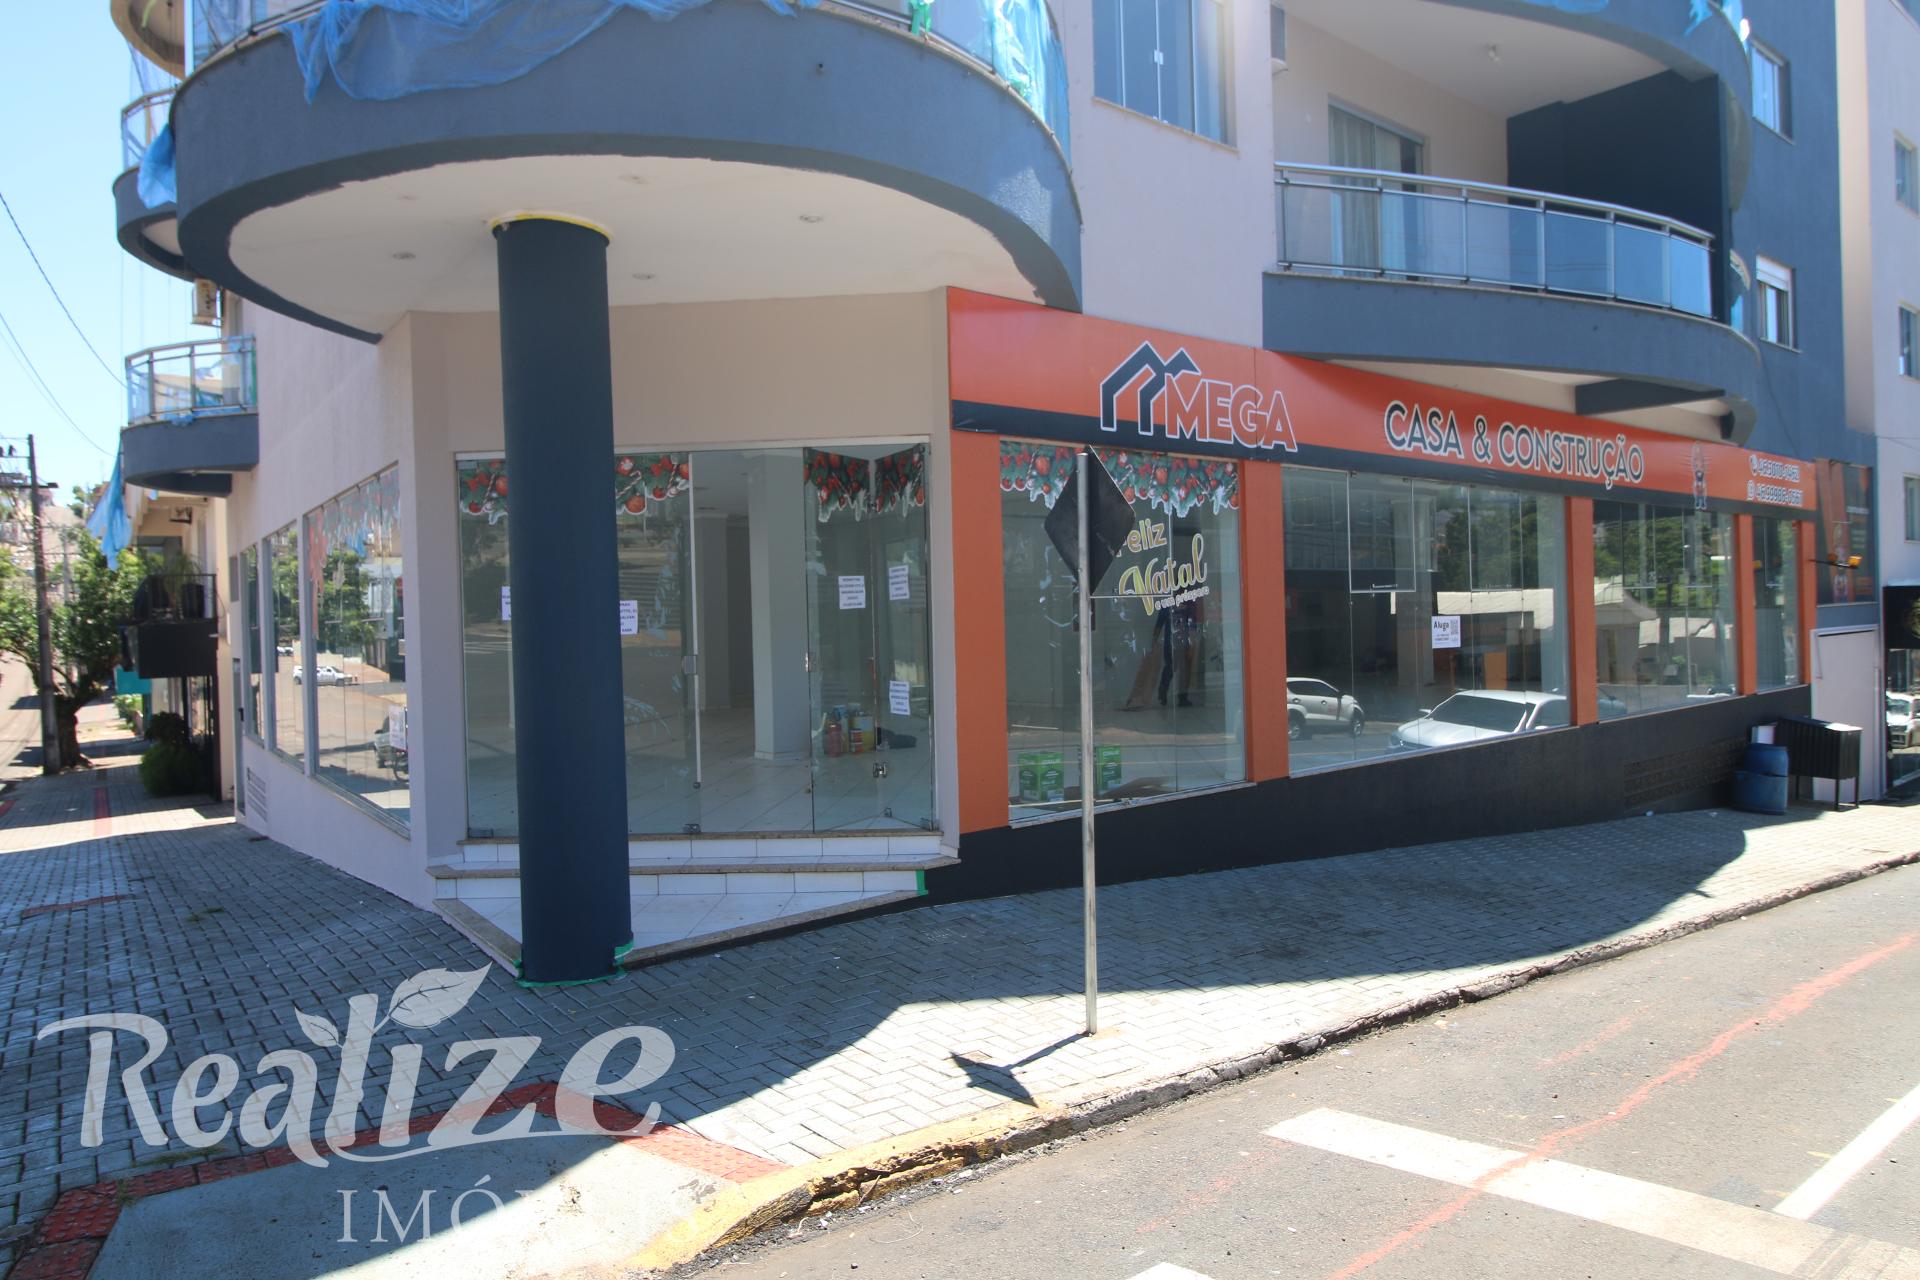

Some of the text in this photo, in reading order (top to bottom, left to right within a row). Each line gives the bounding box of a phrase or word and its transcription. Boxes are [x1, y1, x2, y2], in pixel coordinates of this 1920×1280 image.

[1165, 372, 1298, 452] MEGA
[1384, 400, 1645, 490] CASA & CONSTRUÇÃO
[1118, 533, 1208, 616] Natal
